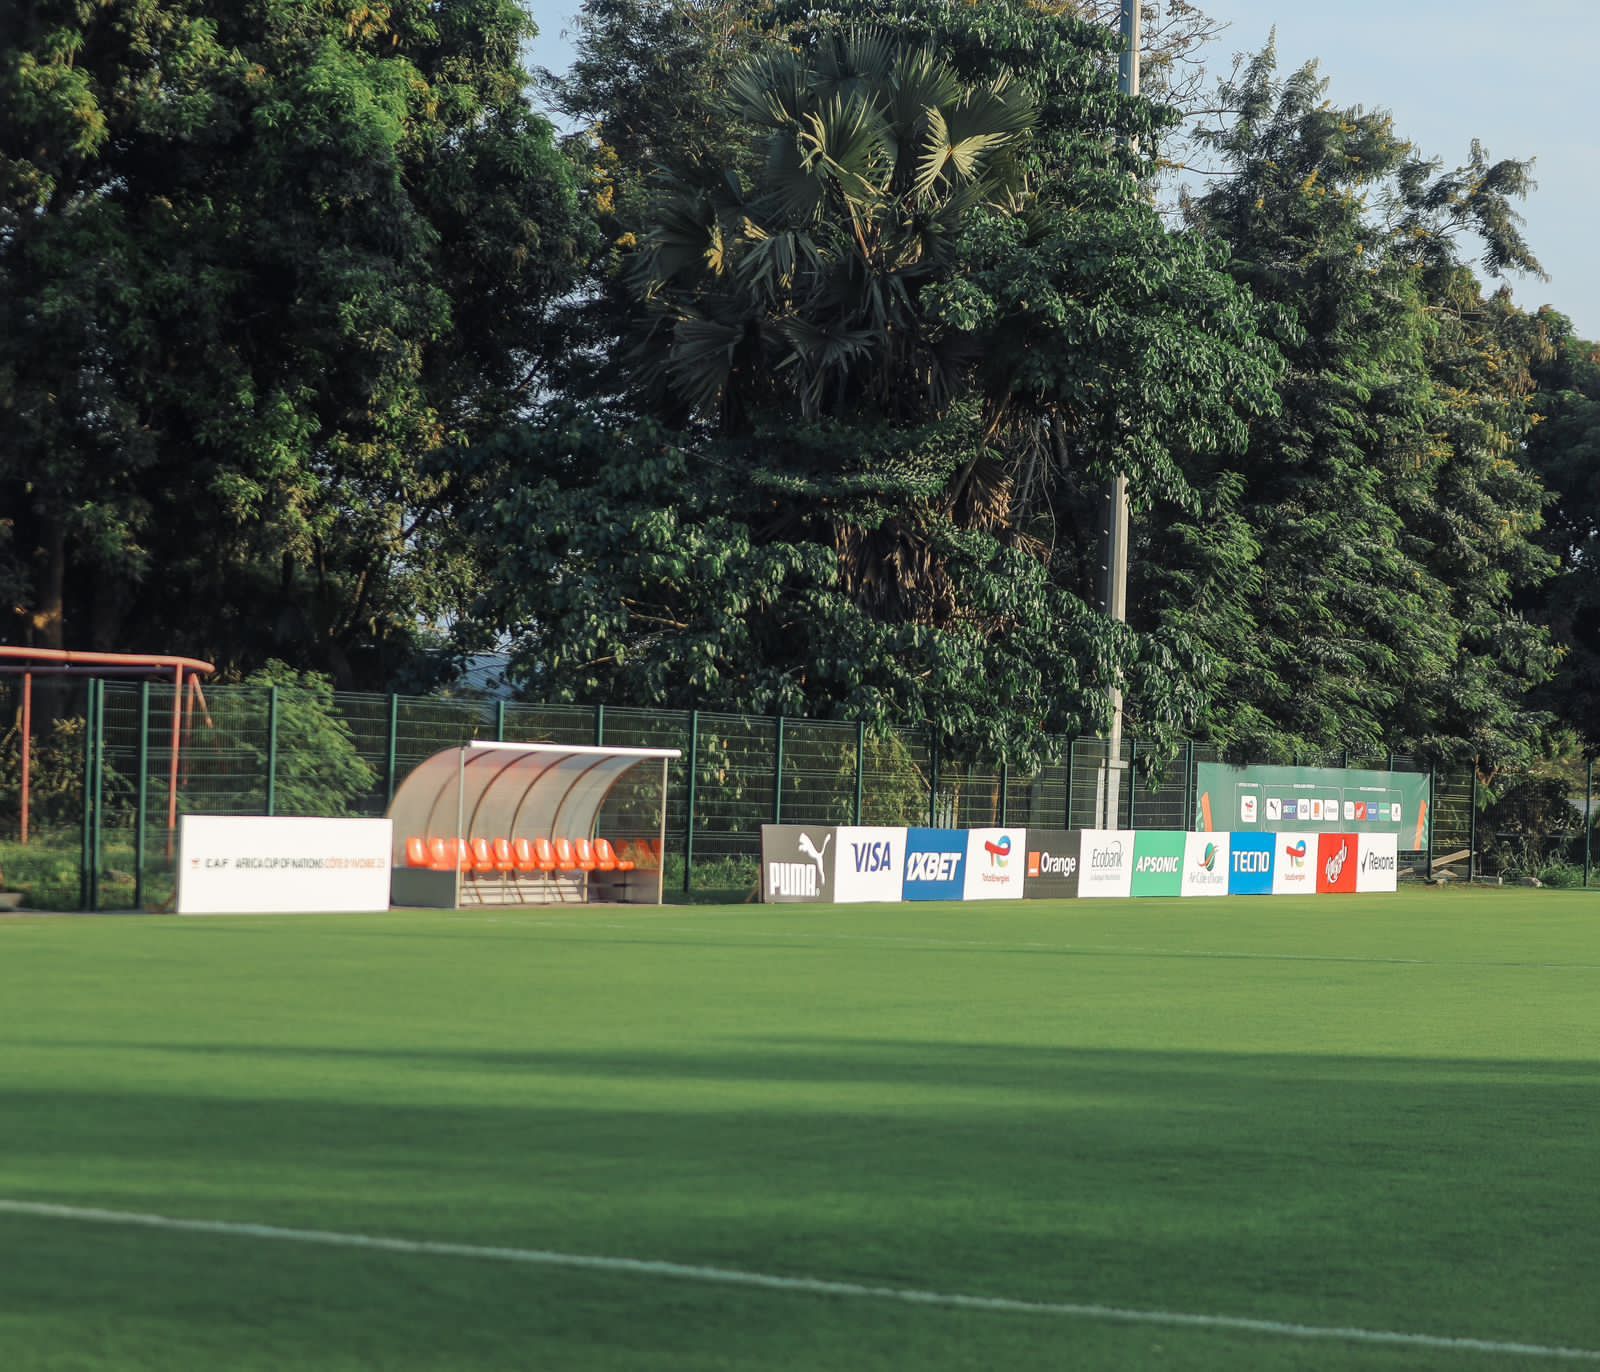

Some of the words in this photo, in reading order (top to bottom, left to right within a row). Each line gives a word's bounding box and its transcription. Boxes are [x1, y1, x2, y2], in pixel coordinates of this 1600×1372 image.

[235, 857, 264, 869] AFRICA
[264, 857, 279, 869] CUP
[280, 857, 290, 869] OF
[292, 857, 324, 869] NATIONS
[850, 841, 891, 872] VISA
[906, 852, 962, 881] 1XBET
[1041, 852, 1076, 877] Orange
[1091, 841, 1123, 868] Ecobank
[1136, 856, 1179, 873] APSONIC
[1232, 851, 1270, 872] TECNO
[1369, 852, 1394, 870] Rexona
[769, 862, 816, 896] PUMA
